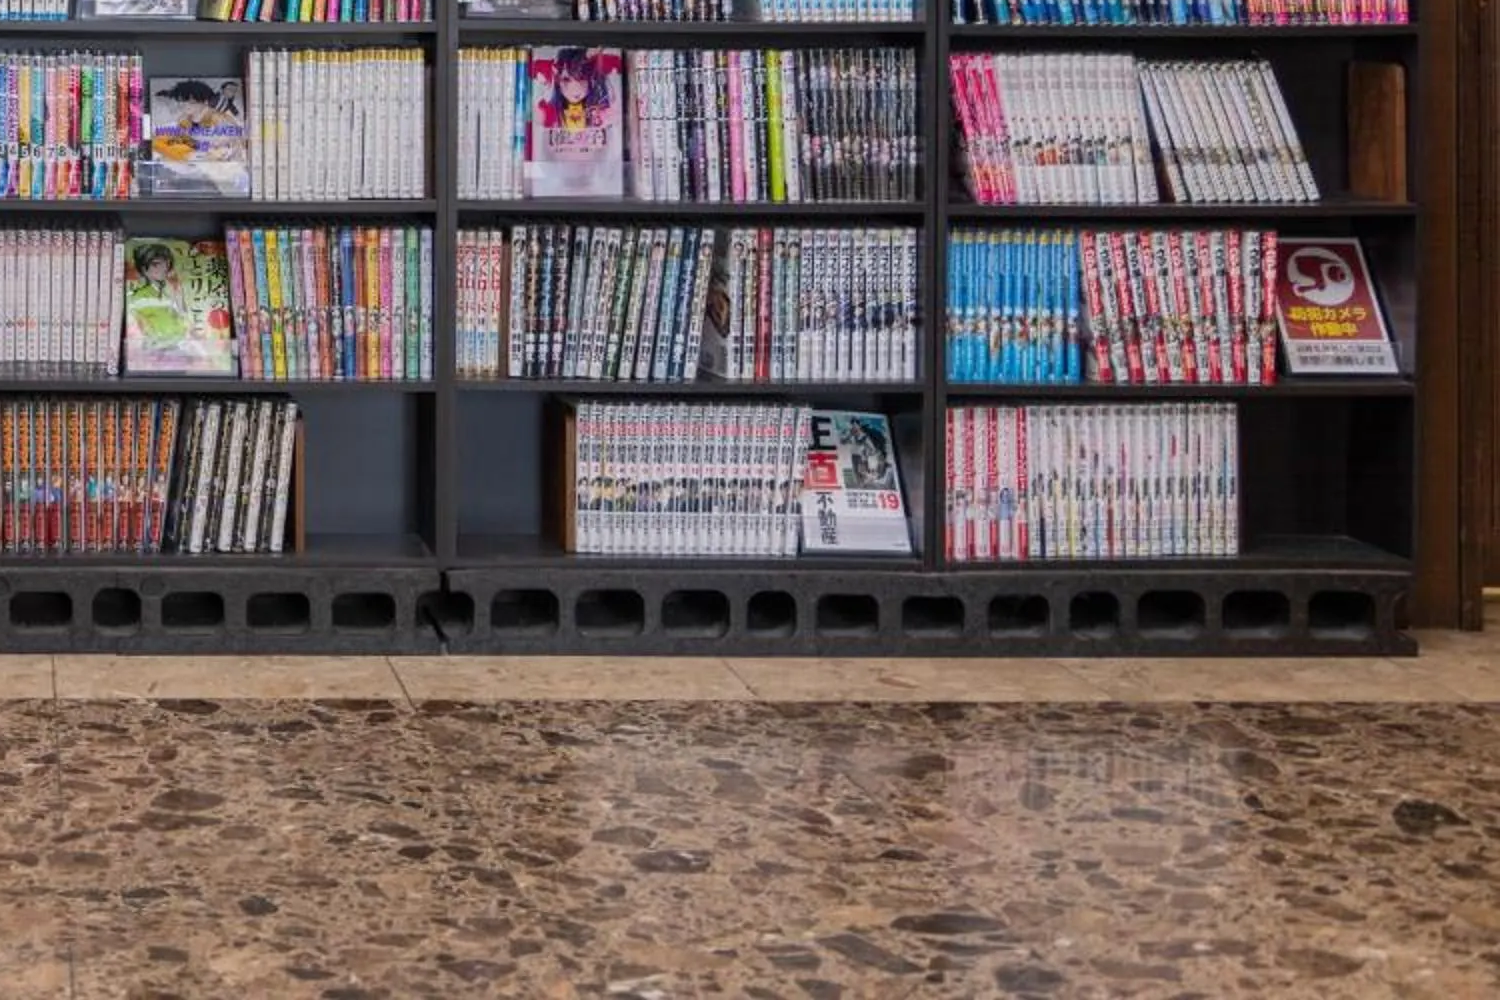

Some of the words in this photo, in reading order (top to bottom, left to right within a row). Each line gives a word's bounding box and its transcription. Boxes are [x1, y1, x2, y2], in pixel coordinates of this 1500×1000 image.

[1288, 306, 1366, 321] 防犯カメラ
[877, 492, 900, 509] 19
